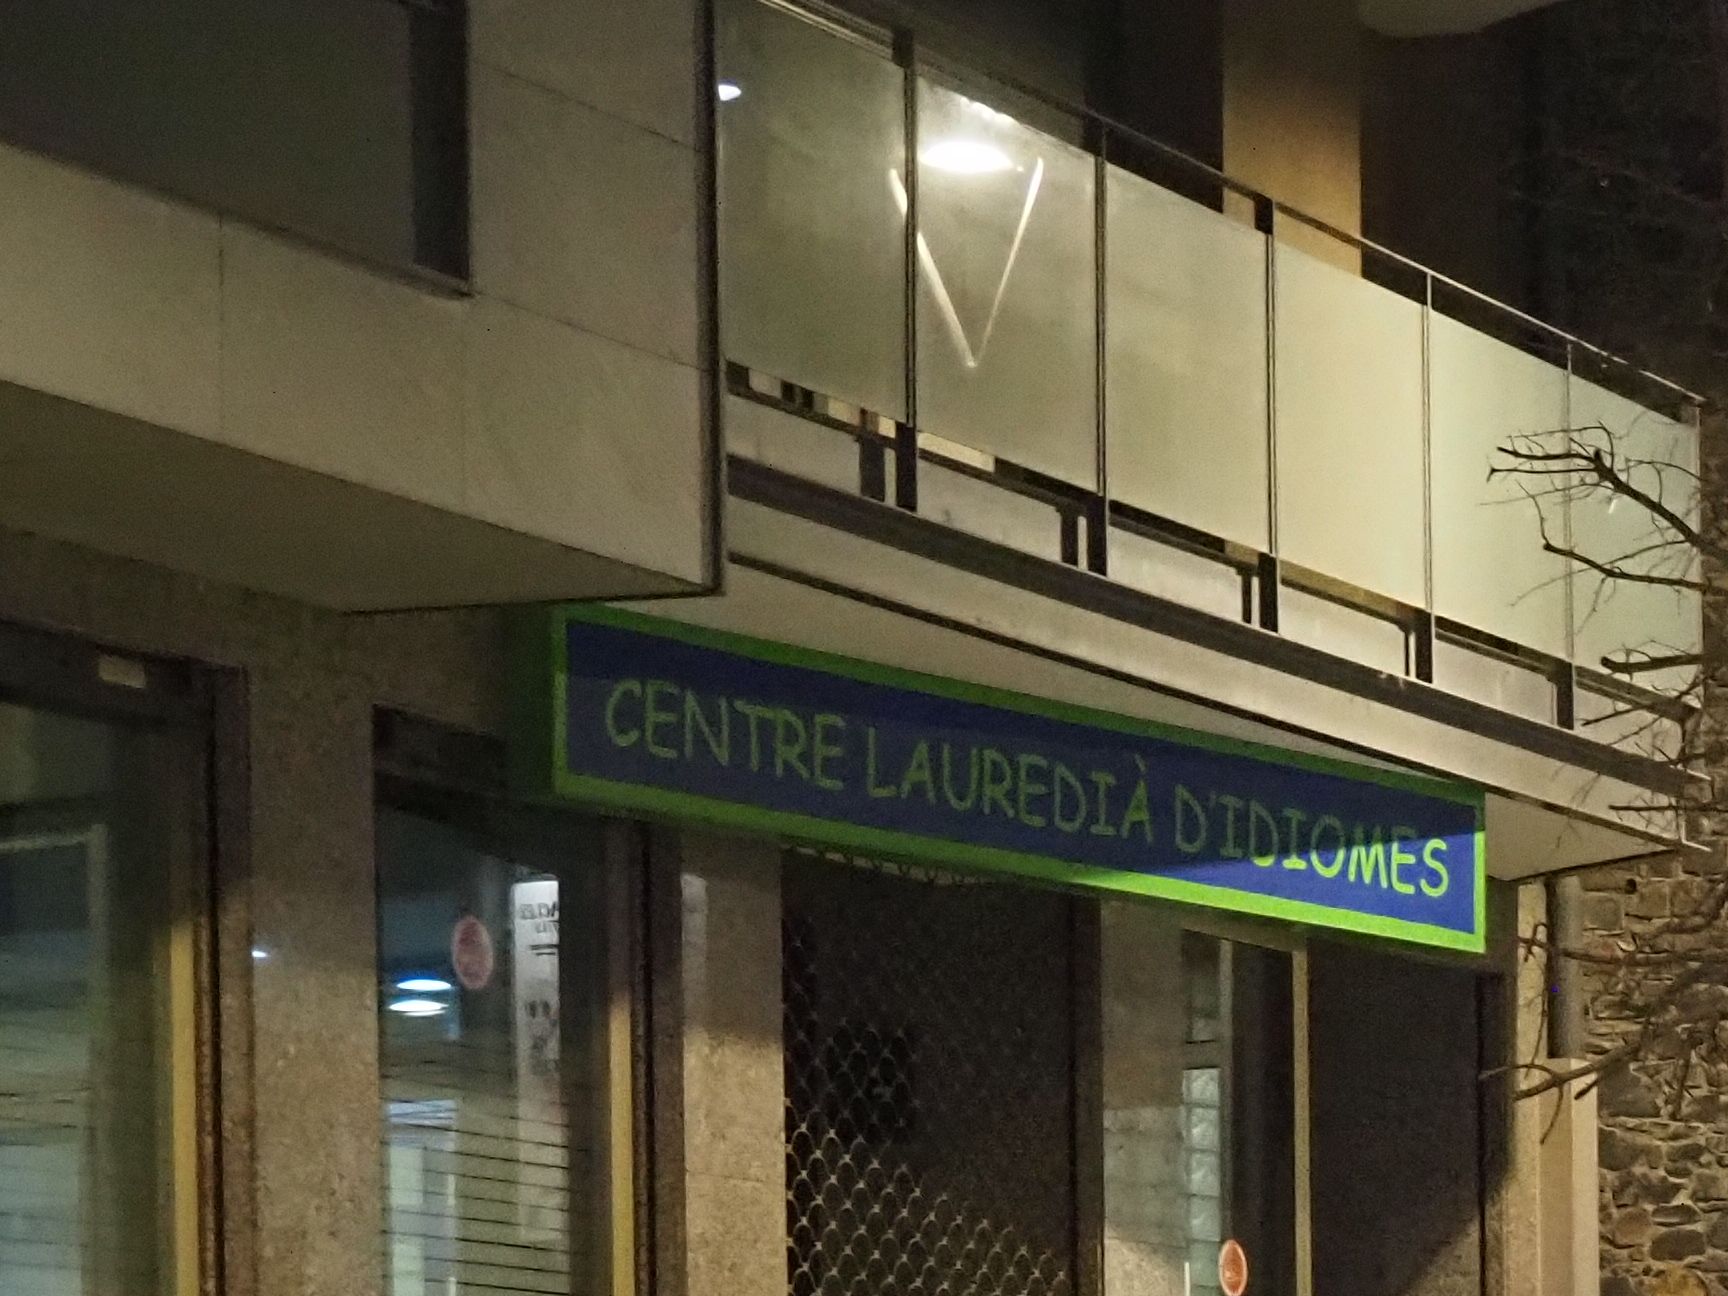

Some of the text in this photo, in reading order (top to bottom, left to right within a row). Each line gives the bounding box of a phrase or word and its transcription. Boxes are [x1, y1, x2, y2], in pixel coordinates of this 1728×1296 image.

[605, 678, 1449, 897] CENTRE LAUREDIÀ D'IDIOMES
